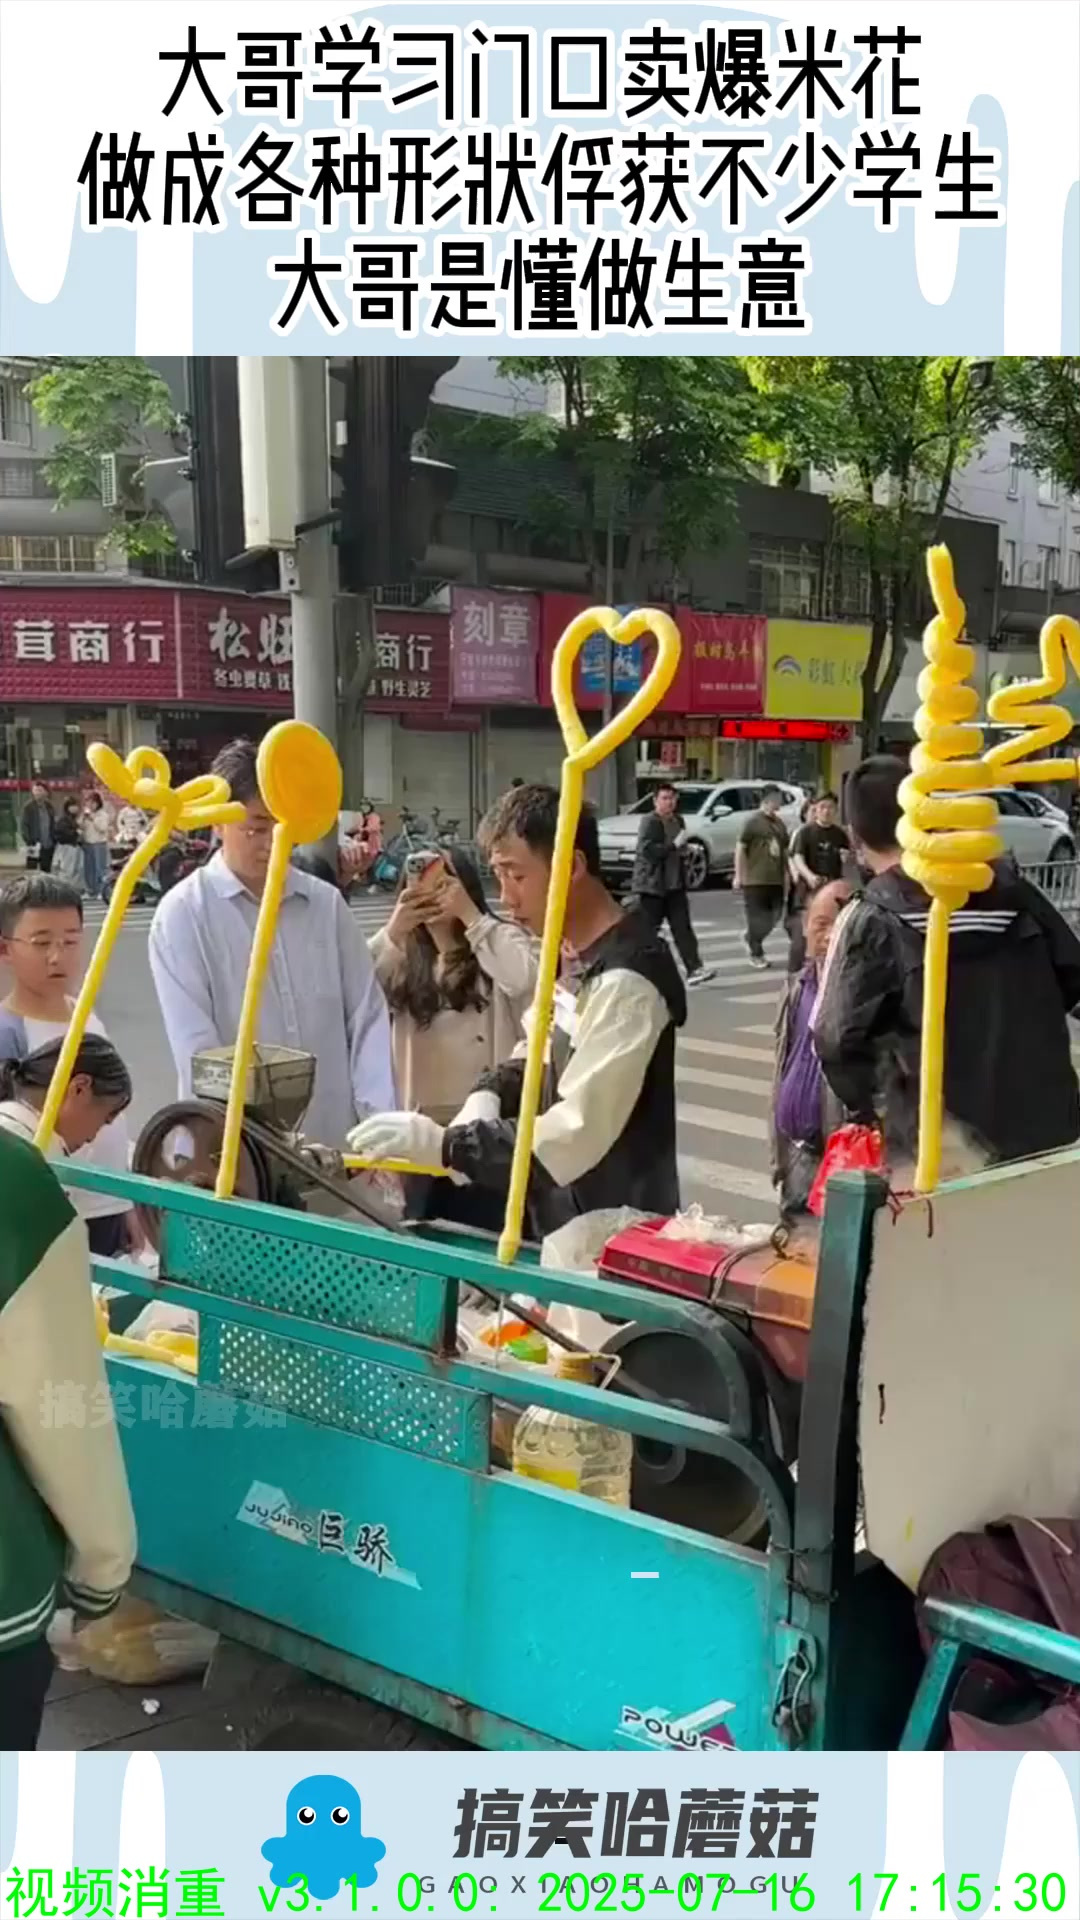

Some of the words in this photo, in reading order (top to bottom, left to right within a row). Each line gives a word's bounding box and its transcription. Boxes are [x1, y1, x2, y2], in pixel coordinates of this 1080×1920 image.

[13, 619, 165, 665] 茸商行
[463, 601, 532, 648] 刻章
[375, 632, 433, 671] 商行
